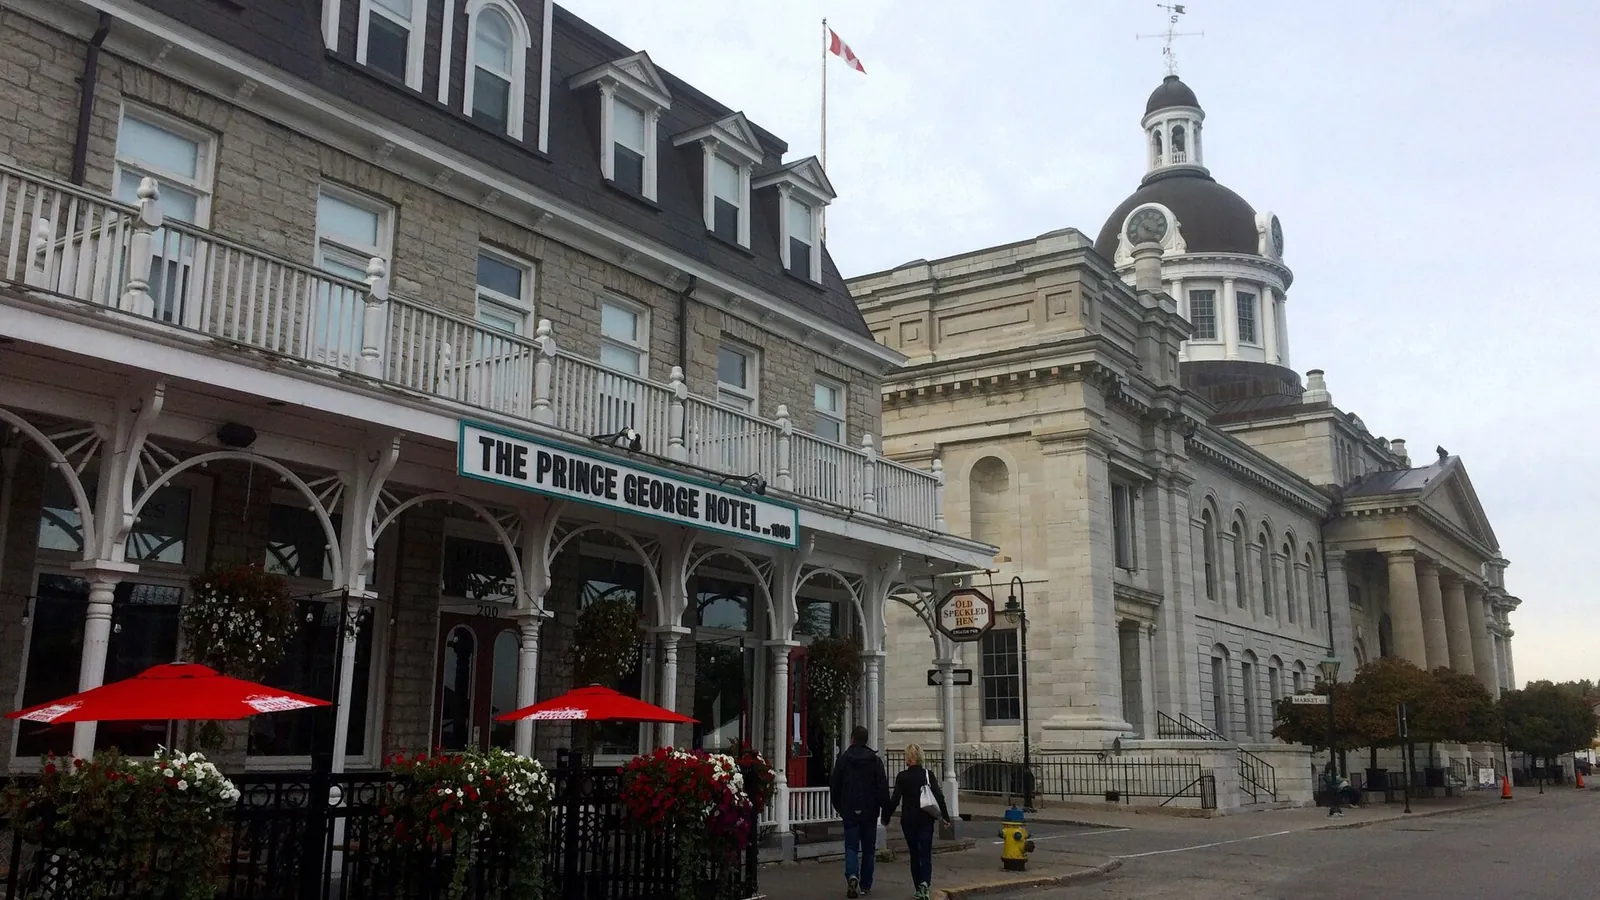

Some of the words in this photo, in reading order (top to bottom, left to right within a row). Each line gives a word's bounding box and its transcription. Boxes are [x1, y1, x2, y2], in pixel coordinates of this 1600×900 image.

[479, 435, 527, 480] THE
[536, 450, 618, 500] PRINCE
[624, 473, 700, 519] GEORGE
[705, 492, 760, 533] HOTEL
[955, 600, 973, 609] OLD
[477, 604, 499, 618] 200
[943, 608, 987, 618] SPECKLED
[956, 617, 974, 626] HEN
